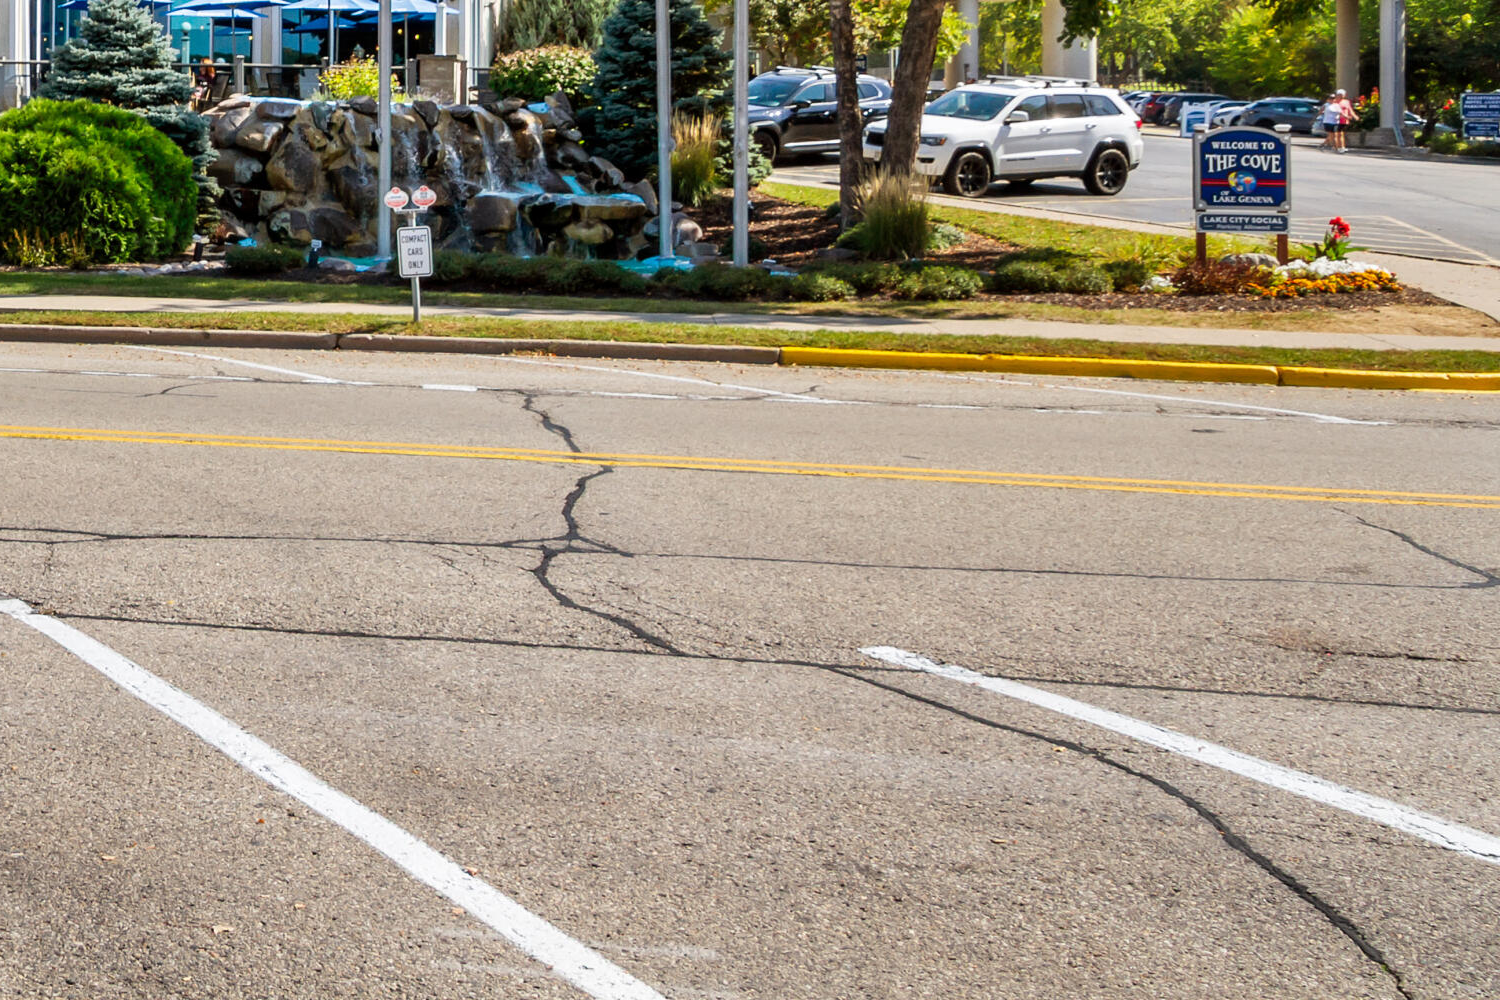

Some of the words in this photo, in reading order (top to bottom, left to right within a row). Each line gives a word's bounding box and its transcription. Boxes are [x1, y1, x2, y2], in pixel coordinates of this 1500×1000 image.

[1212, 141, 1259, 150] WELCOME
[1261, 142, 1275, 150] TO
[1205, 154, 1237, 173] THE
[1241, 154, 1281, 173] COVE
[1213, 195, 1236, 203] LAKE
[1238, 195, 1273, 203] GENEVA
[401, 234, 426, 244] COMPACT
[407, 247, 423, 256] CARS
[408, 261, 423, 269] ONLY
